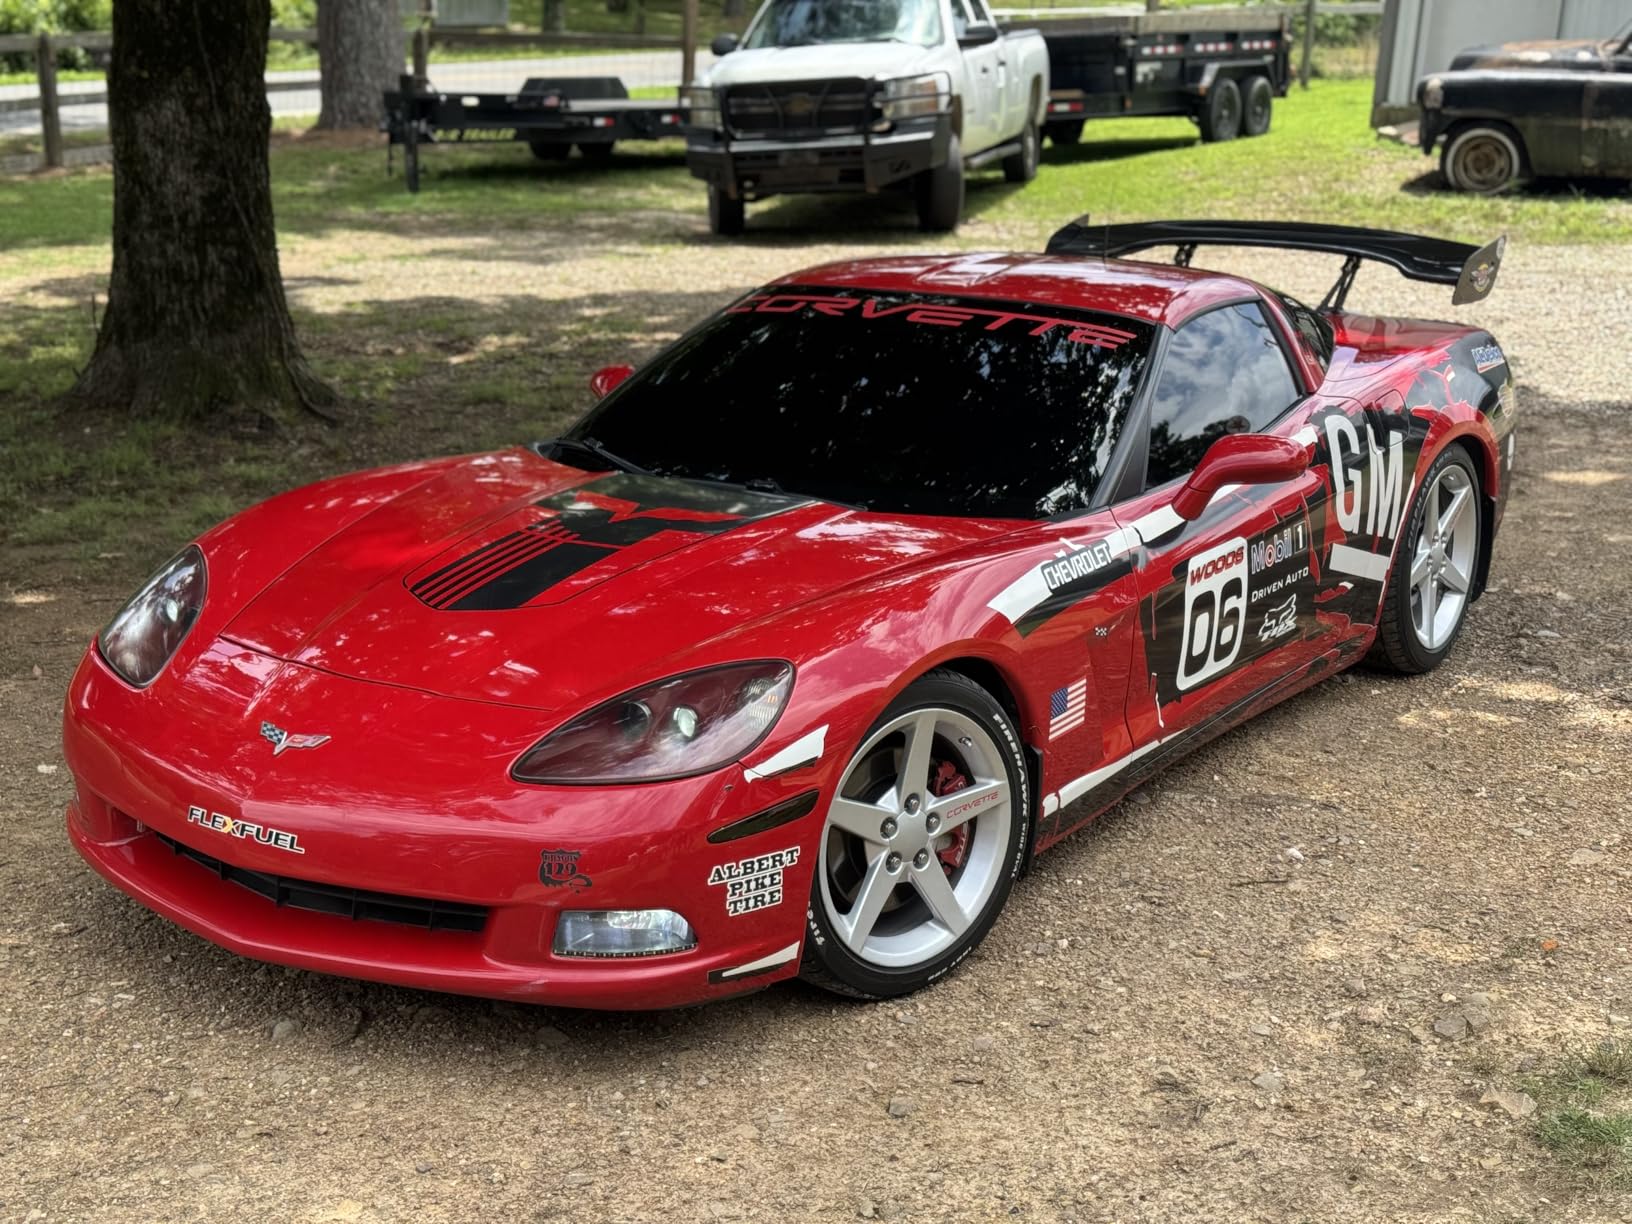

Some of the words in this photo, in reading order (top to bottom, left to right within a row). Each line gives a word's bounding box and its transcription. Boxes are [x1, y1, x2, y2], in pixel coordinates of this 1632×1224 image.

[727, 294, 1137, 350] CORVETTE
[1325, 414, 1404, 541] GM
[1043, 542, 1114, 590] CHEVROLET
[1190, 546, 1244, 587] WOODS
[1251, 527, 1292, 575] Mobil
[1295, 522, 1305, 551] 1
[1251, 579, 1284, 603] DRIVEN
[1285, 566, 1309, 587] AUTO
[1184, 576, 1243, 678] 06
[992, 713, 1028, 816] FIREHAWK
[947, 790, 1000, 819] CORVETTE
[188, 805, 305, 854] FLEXFUEL
[544, 862, 577, 878] 129
[709, 847, 799, 884] ALBERT
[729, 870, 782, 897] PIKE
[727, 887, 782, 916] TIRE
